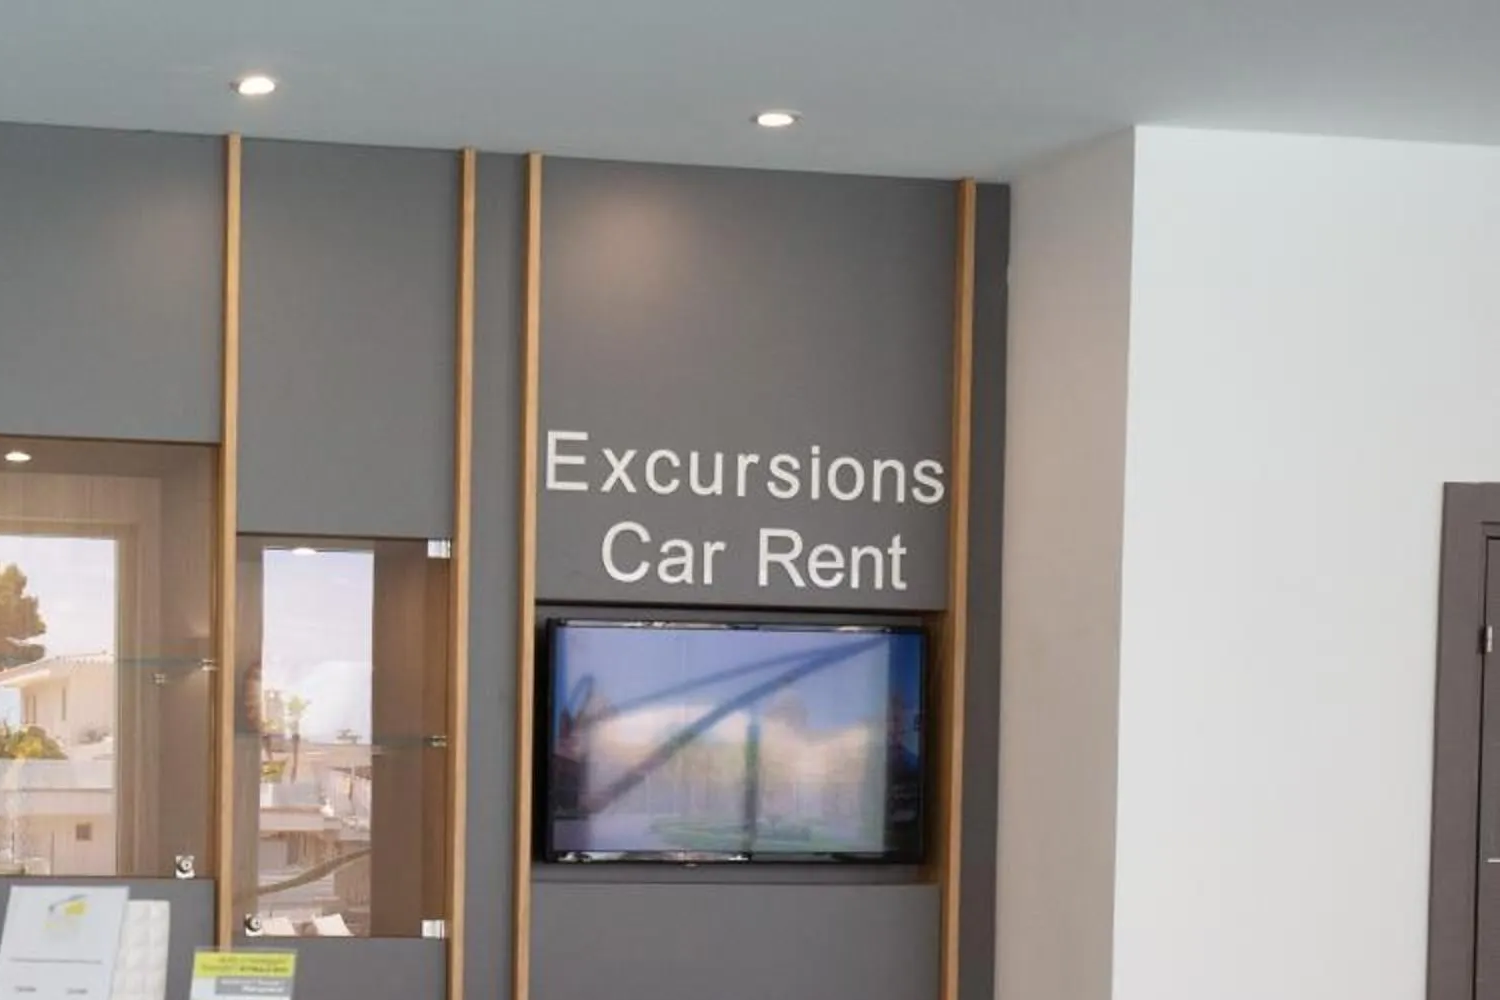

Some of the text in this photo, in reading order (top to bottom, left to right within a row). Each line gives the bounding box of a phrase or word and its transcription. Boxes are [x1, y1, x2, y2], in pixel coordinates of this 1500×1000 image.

[545, 429, 944, 503] Excursions
[601, 520, 907, 590] Car Rent
